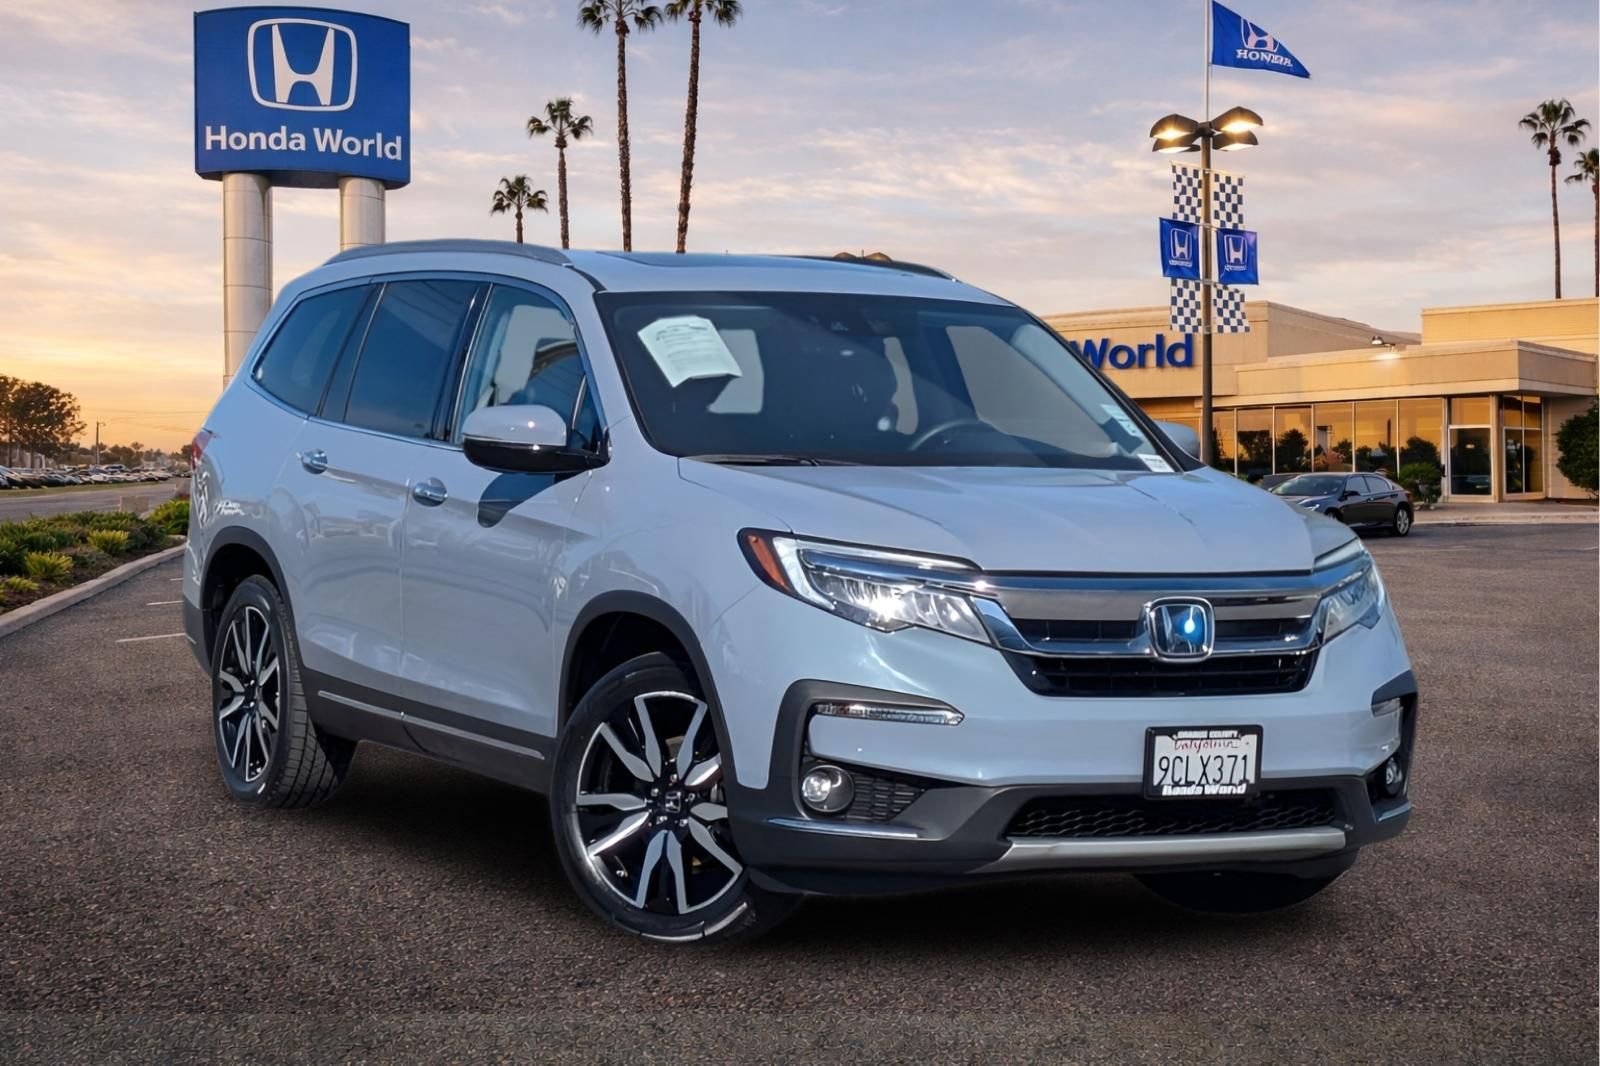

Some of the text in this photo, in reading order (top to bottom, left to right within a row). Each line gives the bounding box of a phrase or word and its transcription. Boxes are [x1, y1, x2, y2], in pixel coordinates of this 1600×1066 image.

[205, 125, 402, 160] Honda World
[1158, 754, 1248, 785] 9CLX371
